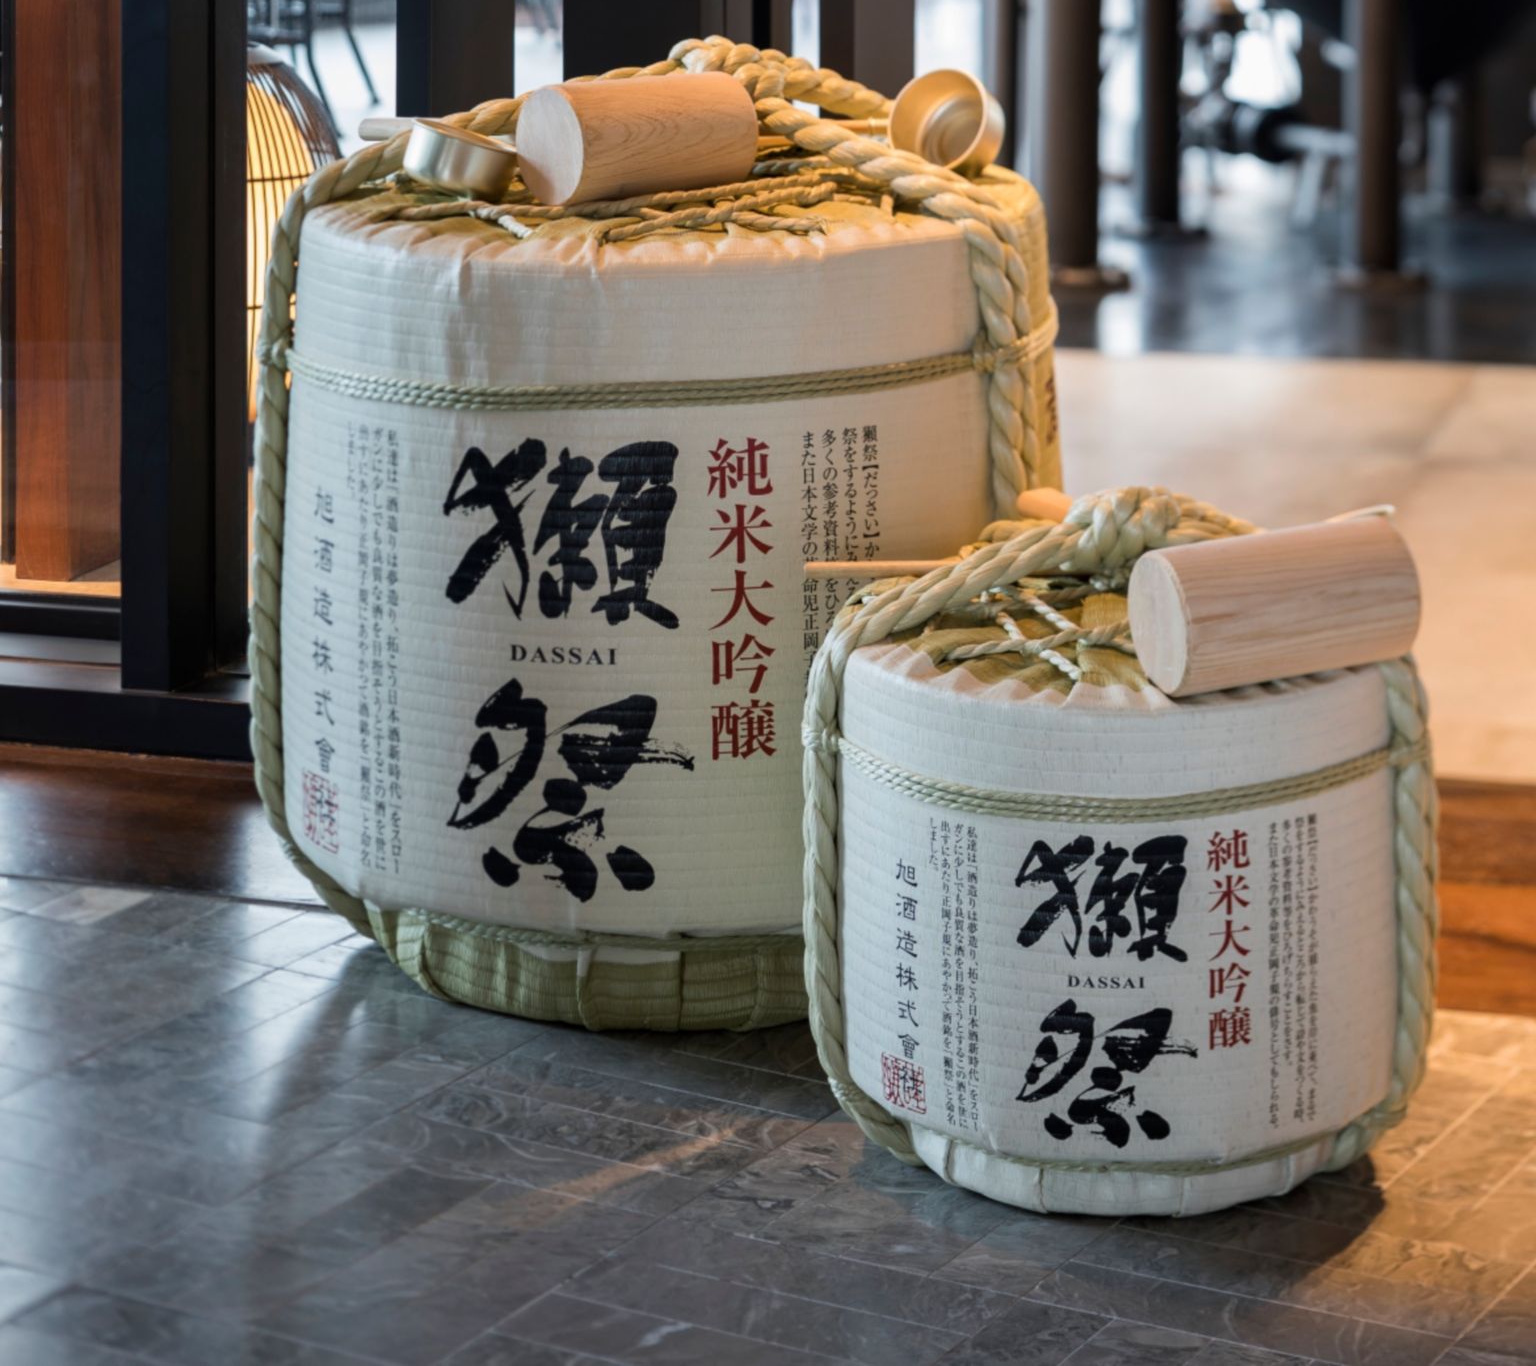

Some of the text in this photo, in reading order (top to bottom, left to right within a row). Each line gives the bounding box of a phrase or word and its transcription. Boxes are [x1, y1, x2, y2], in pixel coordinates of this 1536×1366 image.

[862, 425, 880, 582] 獺祭【だっさい】か
[510, 643, 619, 667] DASSAI
[706, 436, 778, 760] 純米大吟醸
[1067, 974, 1146, 990] DASSAI
[1207, 829, 1251, 1051] 純米大吟醸
